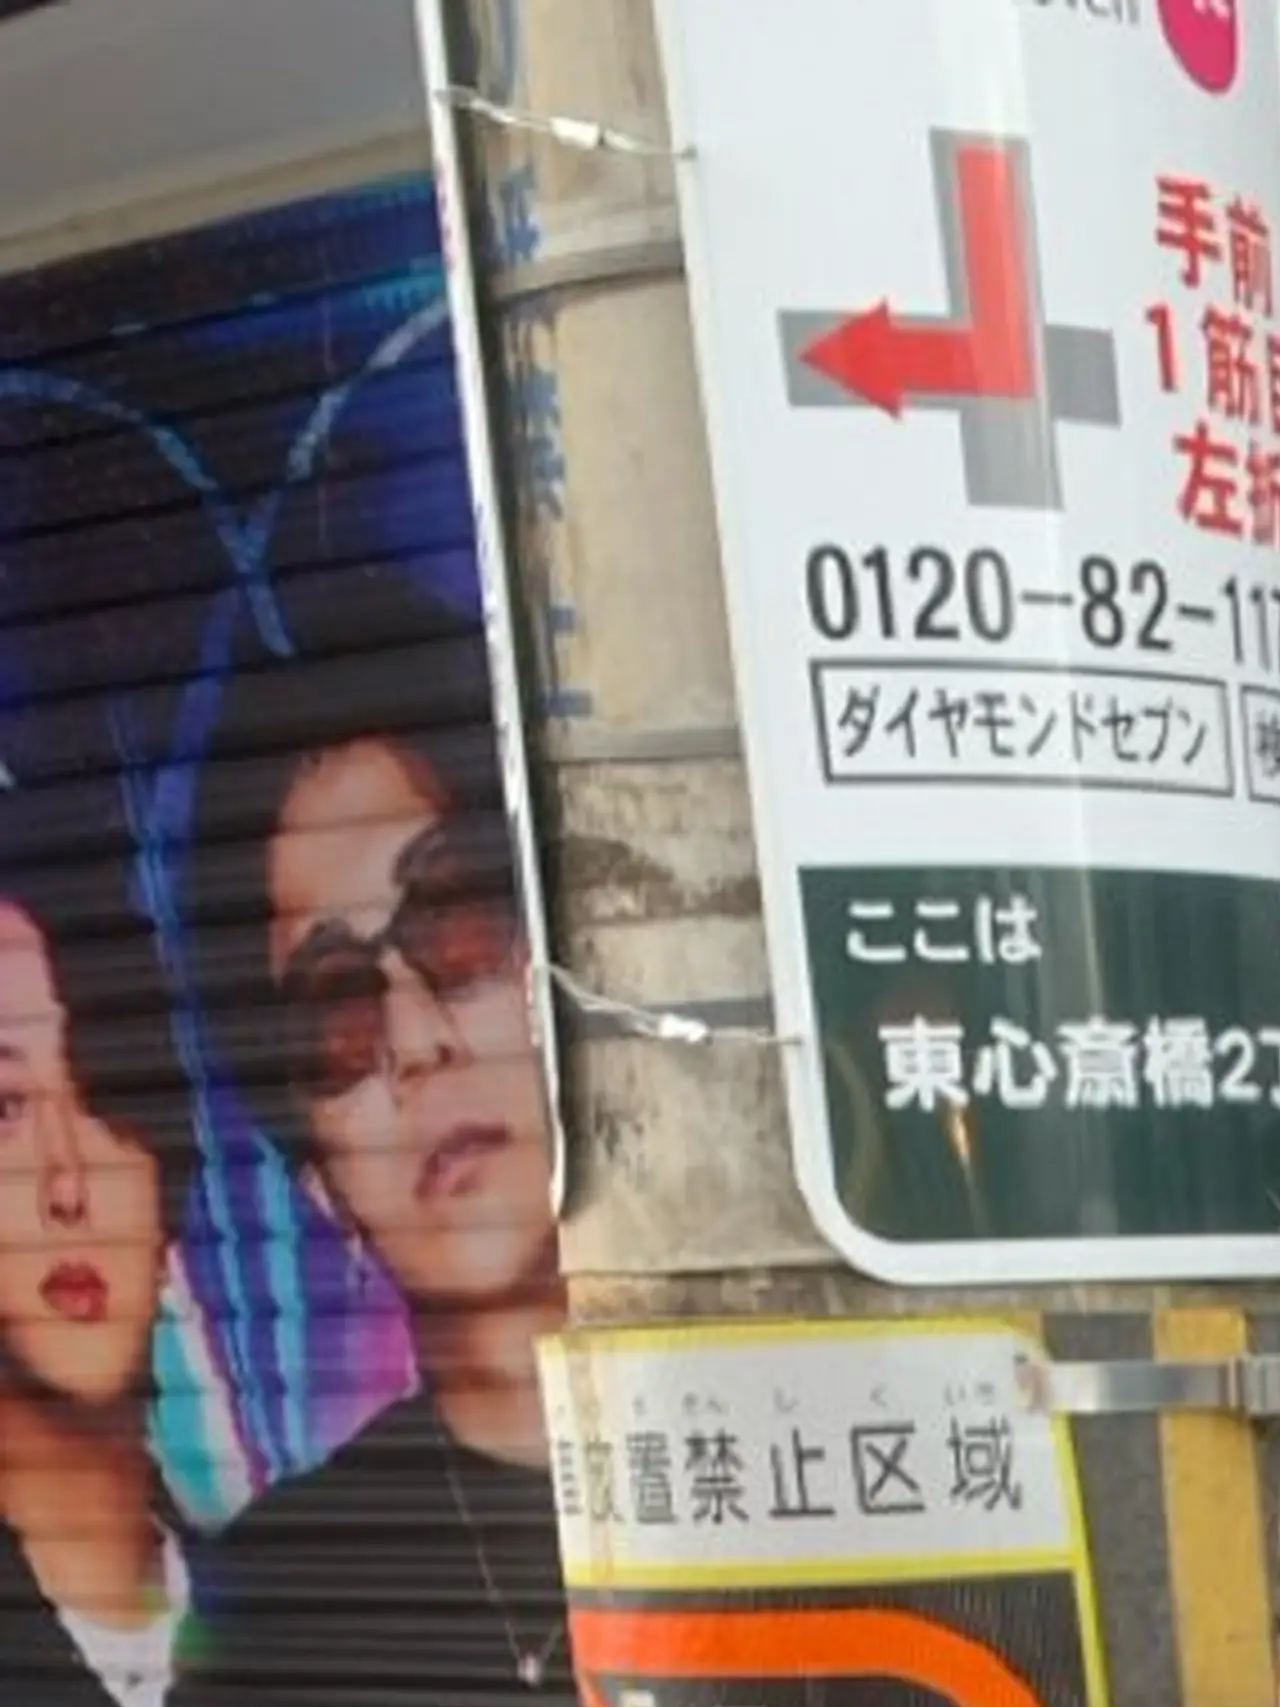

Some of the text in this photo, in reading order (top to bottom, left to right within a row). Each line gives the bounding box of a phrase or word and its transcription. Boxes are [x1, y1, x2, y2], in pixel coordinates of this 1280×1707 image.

[1155, 174, 1274, 317] 手前
[838, 684, 1207, 768] ダイヤモンドセブン
[846, 896, 1042, 966] ここは
